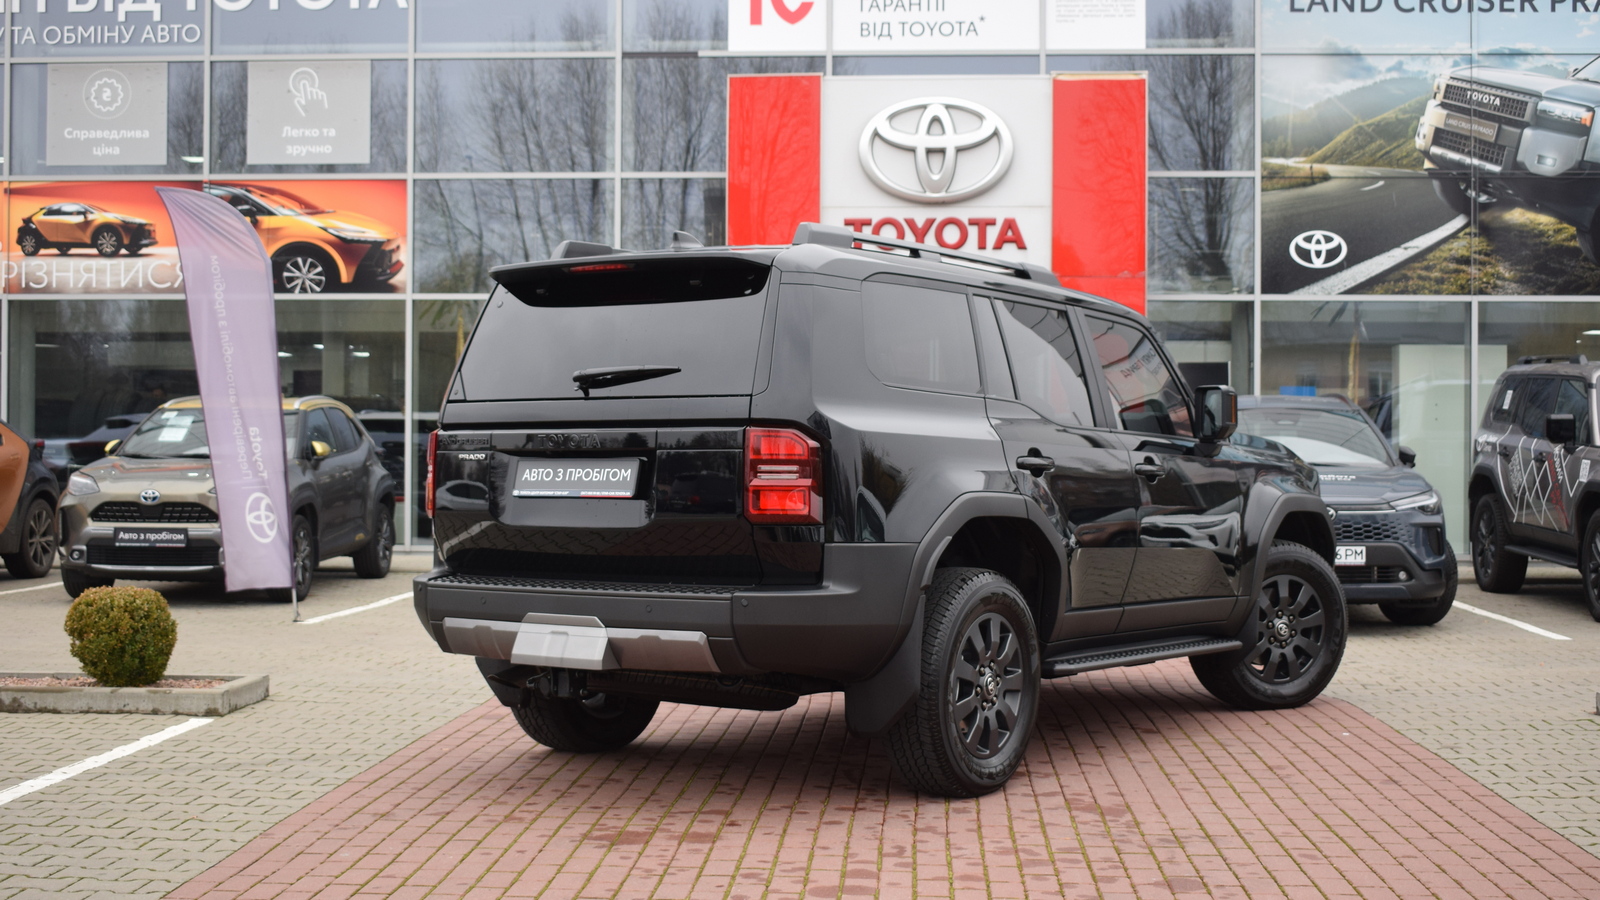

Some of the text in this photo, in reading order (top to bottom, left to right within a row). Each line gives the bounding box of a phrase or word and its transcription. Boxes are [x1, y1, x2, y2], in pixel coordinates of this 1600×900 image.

[12, 26, 36, 45] ТА
[43, 25, 135, 45] ОБМІНУ
[141, 23, 201, 44] АВТО
[860, 22, 892, 40] ВІД
[1466, 91, 1500, 106] TOYOTA
[64, 128, 150, 141] Справедлива
[282, 126, 336, 137] Легко та
[92, 144, 120, 156] ціна
[286, 145, 332, 156] зручно
[844, 217, 1027, 250] TOYOTA
[537, 434, 601, 449] TOYOTA
[458, 453, 486, 461] PRADO
[522, 468, 553, 481] АВТО
[566, 468, 631, 481] ПРОБІГОМ
[119, 531, 138, 540] Авто
[146, 531, 184, 541] пробігом
[1345, 549, 1363, 560] PM
